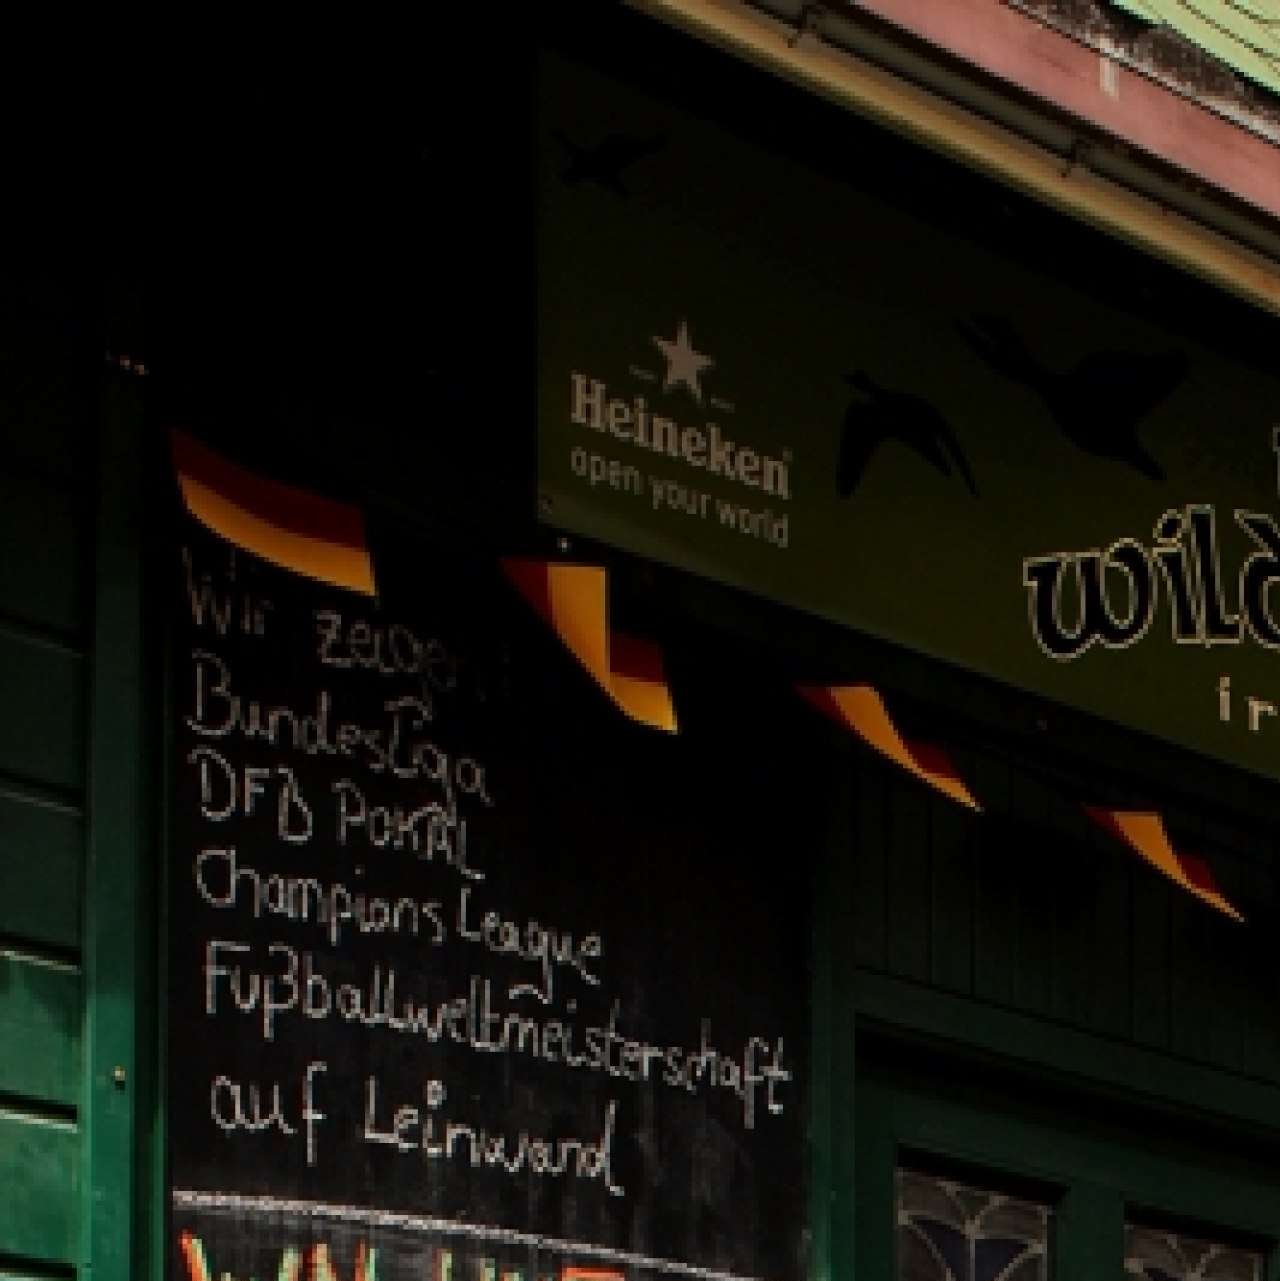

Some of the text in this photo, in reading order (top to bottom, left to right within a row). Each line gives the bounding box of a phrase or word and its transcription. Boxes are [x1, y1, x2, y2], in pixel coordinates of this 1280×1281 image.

[570, 370, 792, 500] Heineken
[570, 447, 789, 548] open your world
[195, 850, 602, 1002] Champions League
[210, 1060, 625, 1196] auf Leinwand
